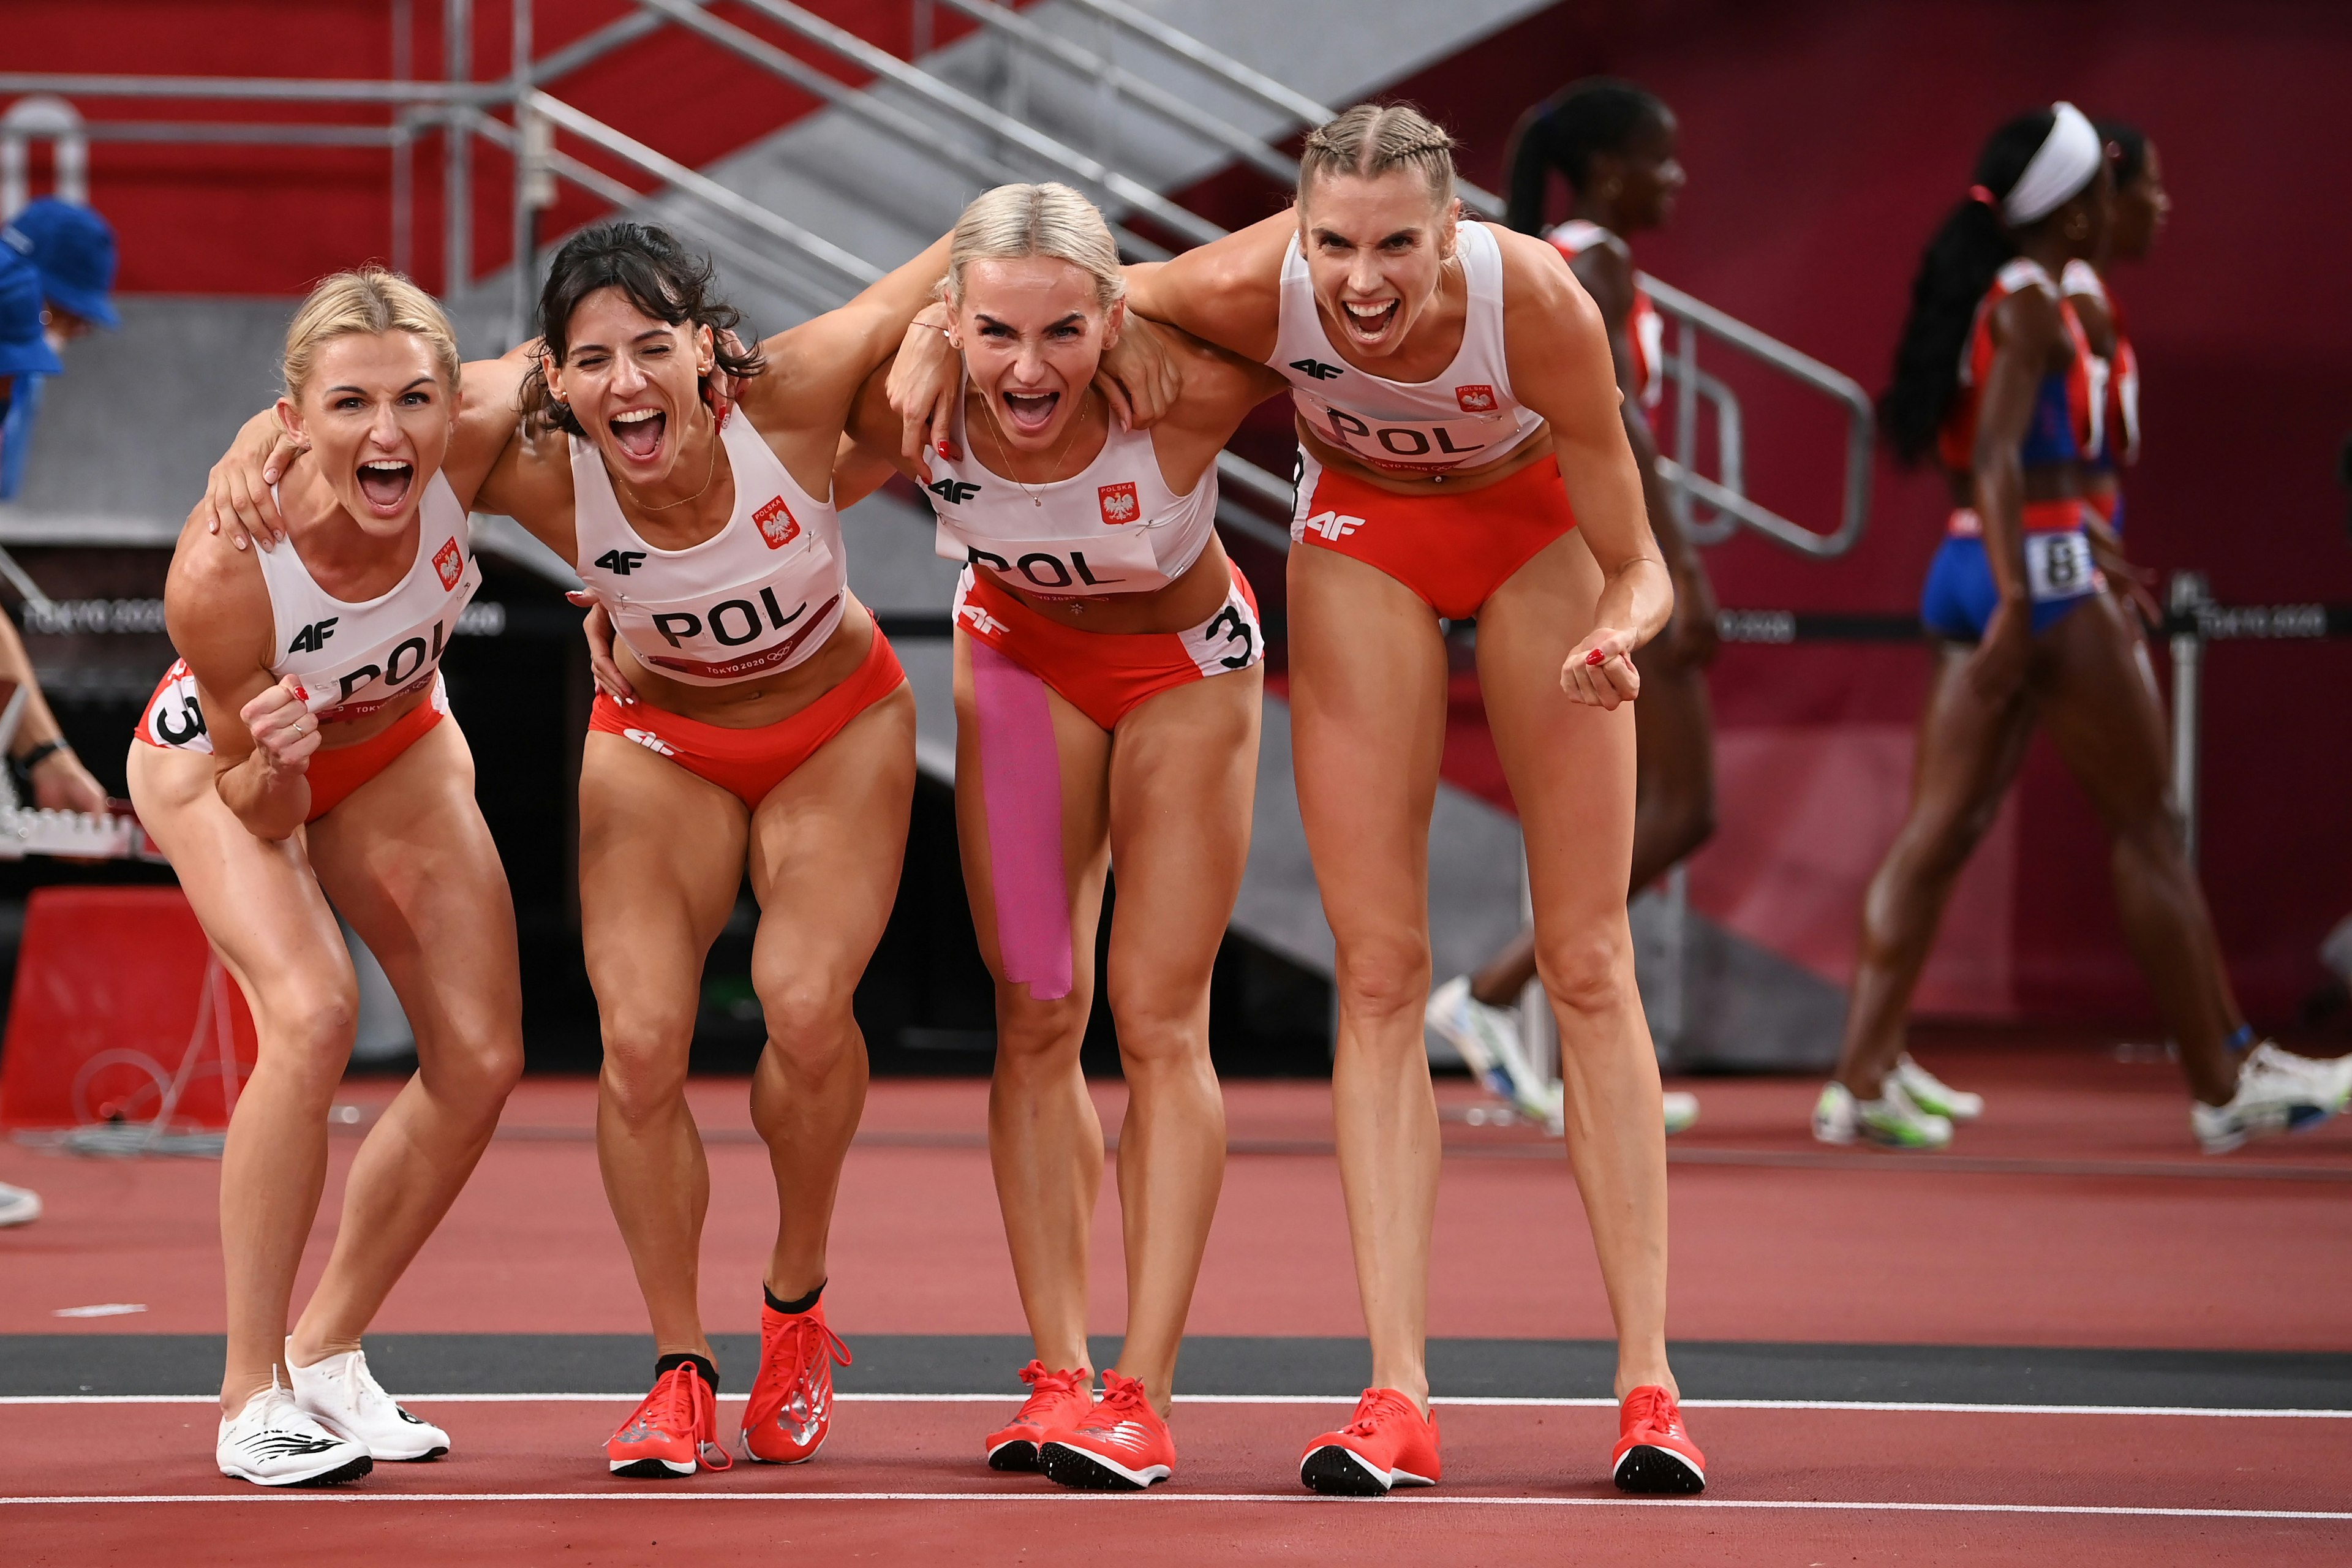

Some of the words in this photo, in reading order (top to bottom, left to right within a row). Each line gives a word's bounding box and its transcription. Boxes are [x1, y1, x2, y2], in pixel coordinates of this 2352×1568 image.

[1289, 358, 1344, 380] 4F
[1327, 405, 1485, 456] POL
[927, 478, 981, 505] 4F
[1101, 484, 1133, 493] POLSKA
[755, 499, 782, 520] POLSKA
[1306, 510, 1366, 541] 4F
[434, 540, 453, 564] POLSKA
[594, 549, 647, 575] 4F
[652, 586, 807, 649] POL
[288, 617, 339, 654] 4F
[1205, 605, 1252, 668] 3
[706, 665, 739, 674] TOKYO
[741, 658, 765, 669] 2020
